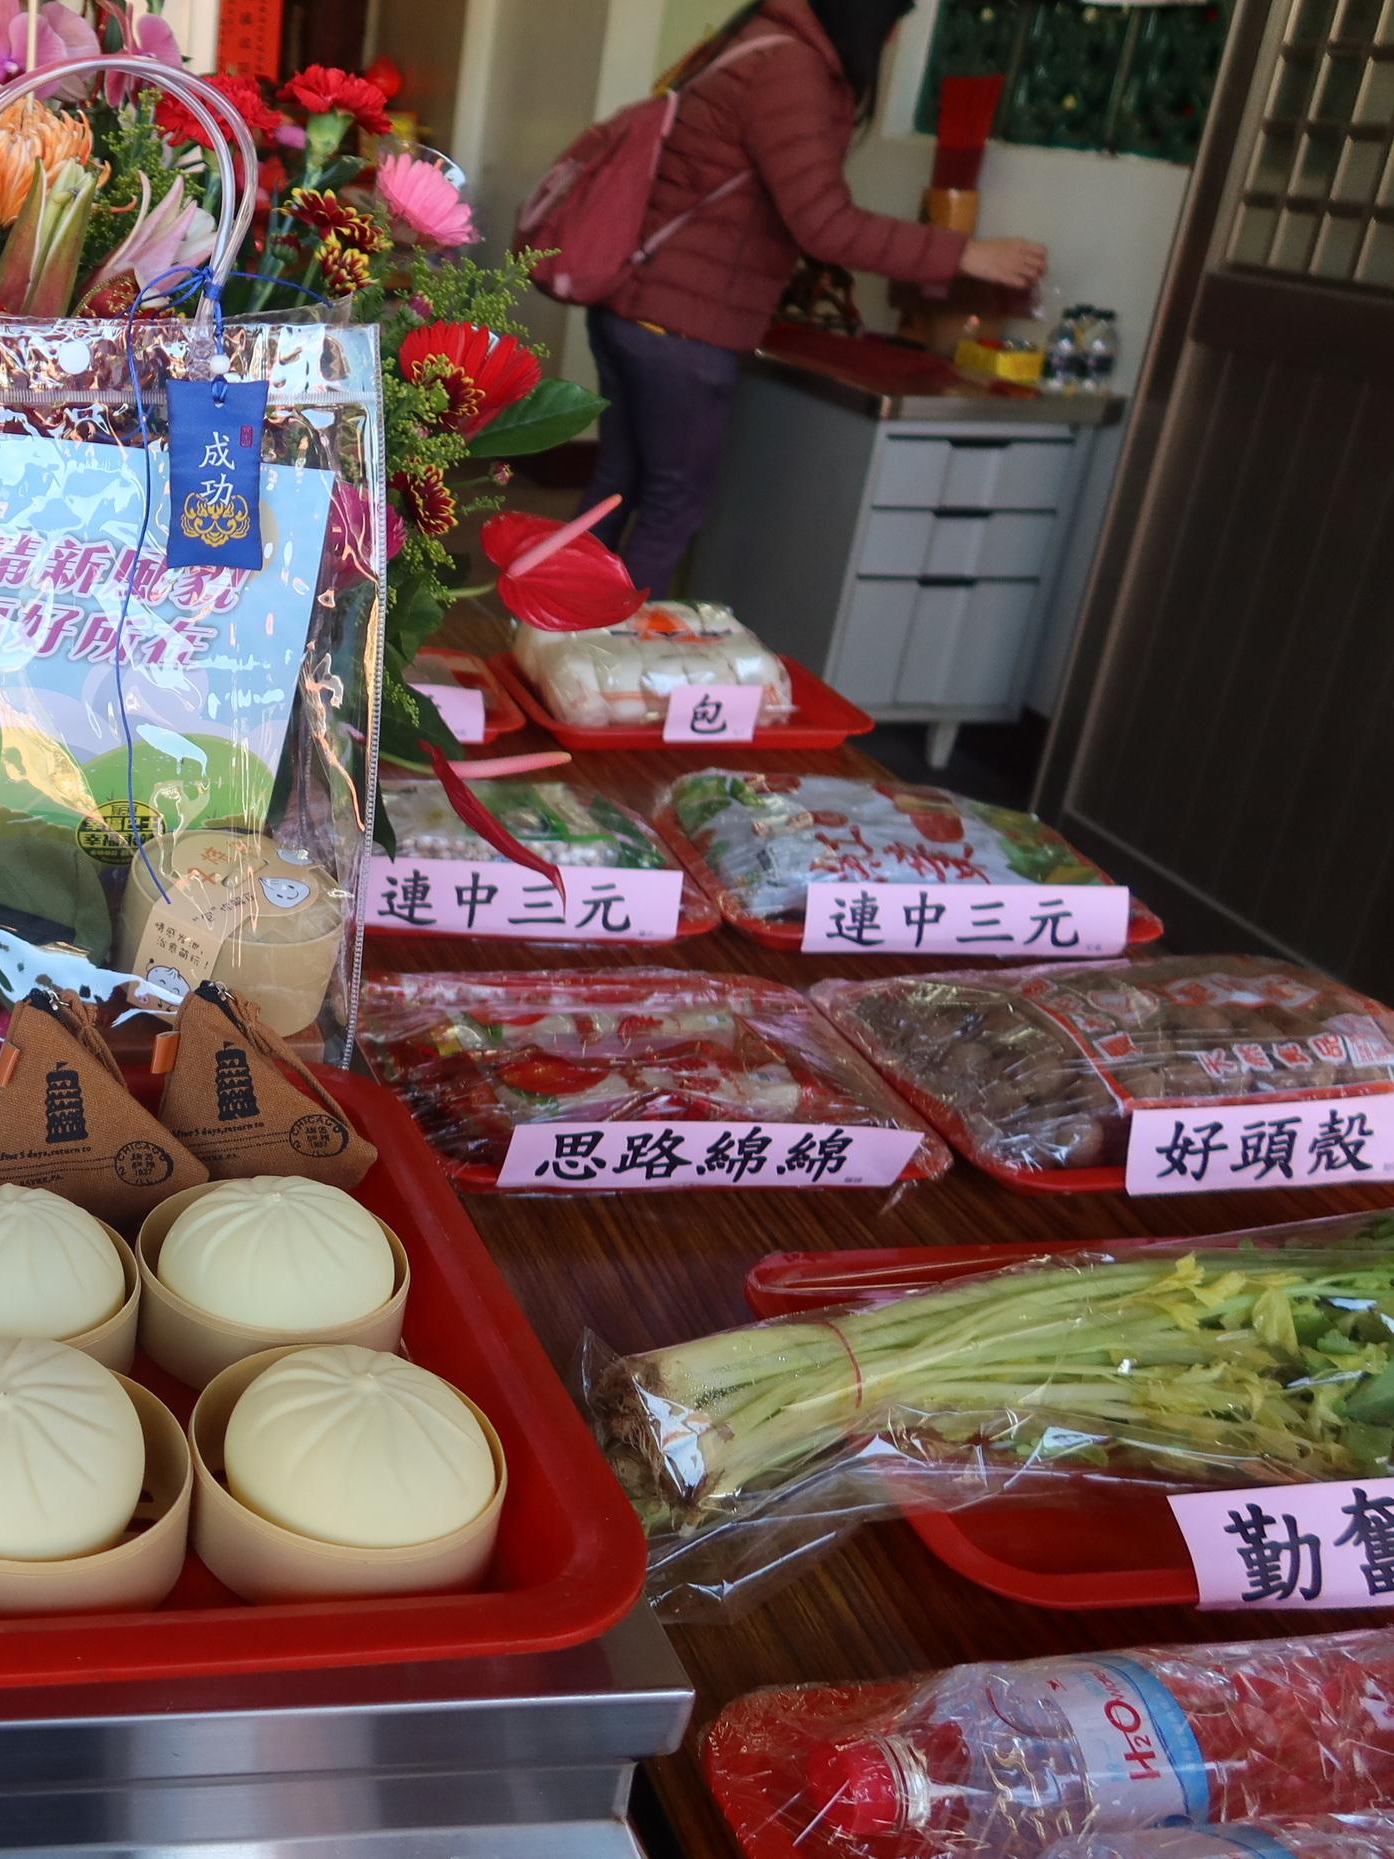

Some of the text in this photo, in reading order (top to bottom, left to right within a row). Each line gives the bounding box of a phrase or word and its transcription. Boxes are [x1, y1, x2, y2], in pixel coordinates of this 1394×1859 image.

[199, 432, 235, 507] 成功
[377, 869, 631, 933] 連中三元
[826, 889, 1080, 949] 連中三元
[534, 1126, 848, 1184] 思路綿綿
[1155, 1108, 1373, 1182] 好頭殼
